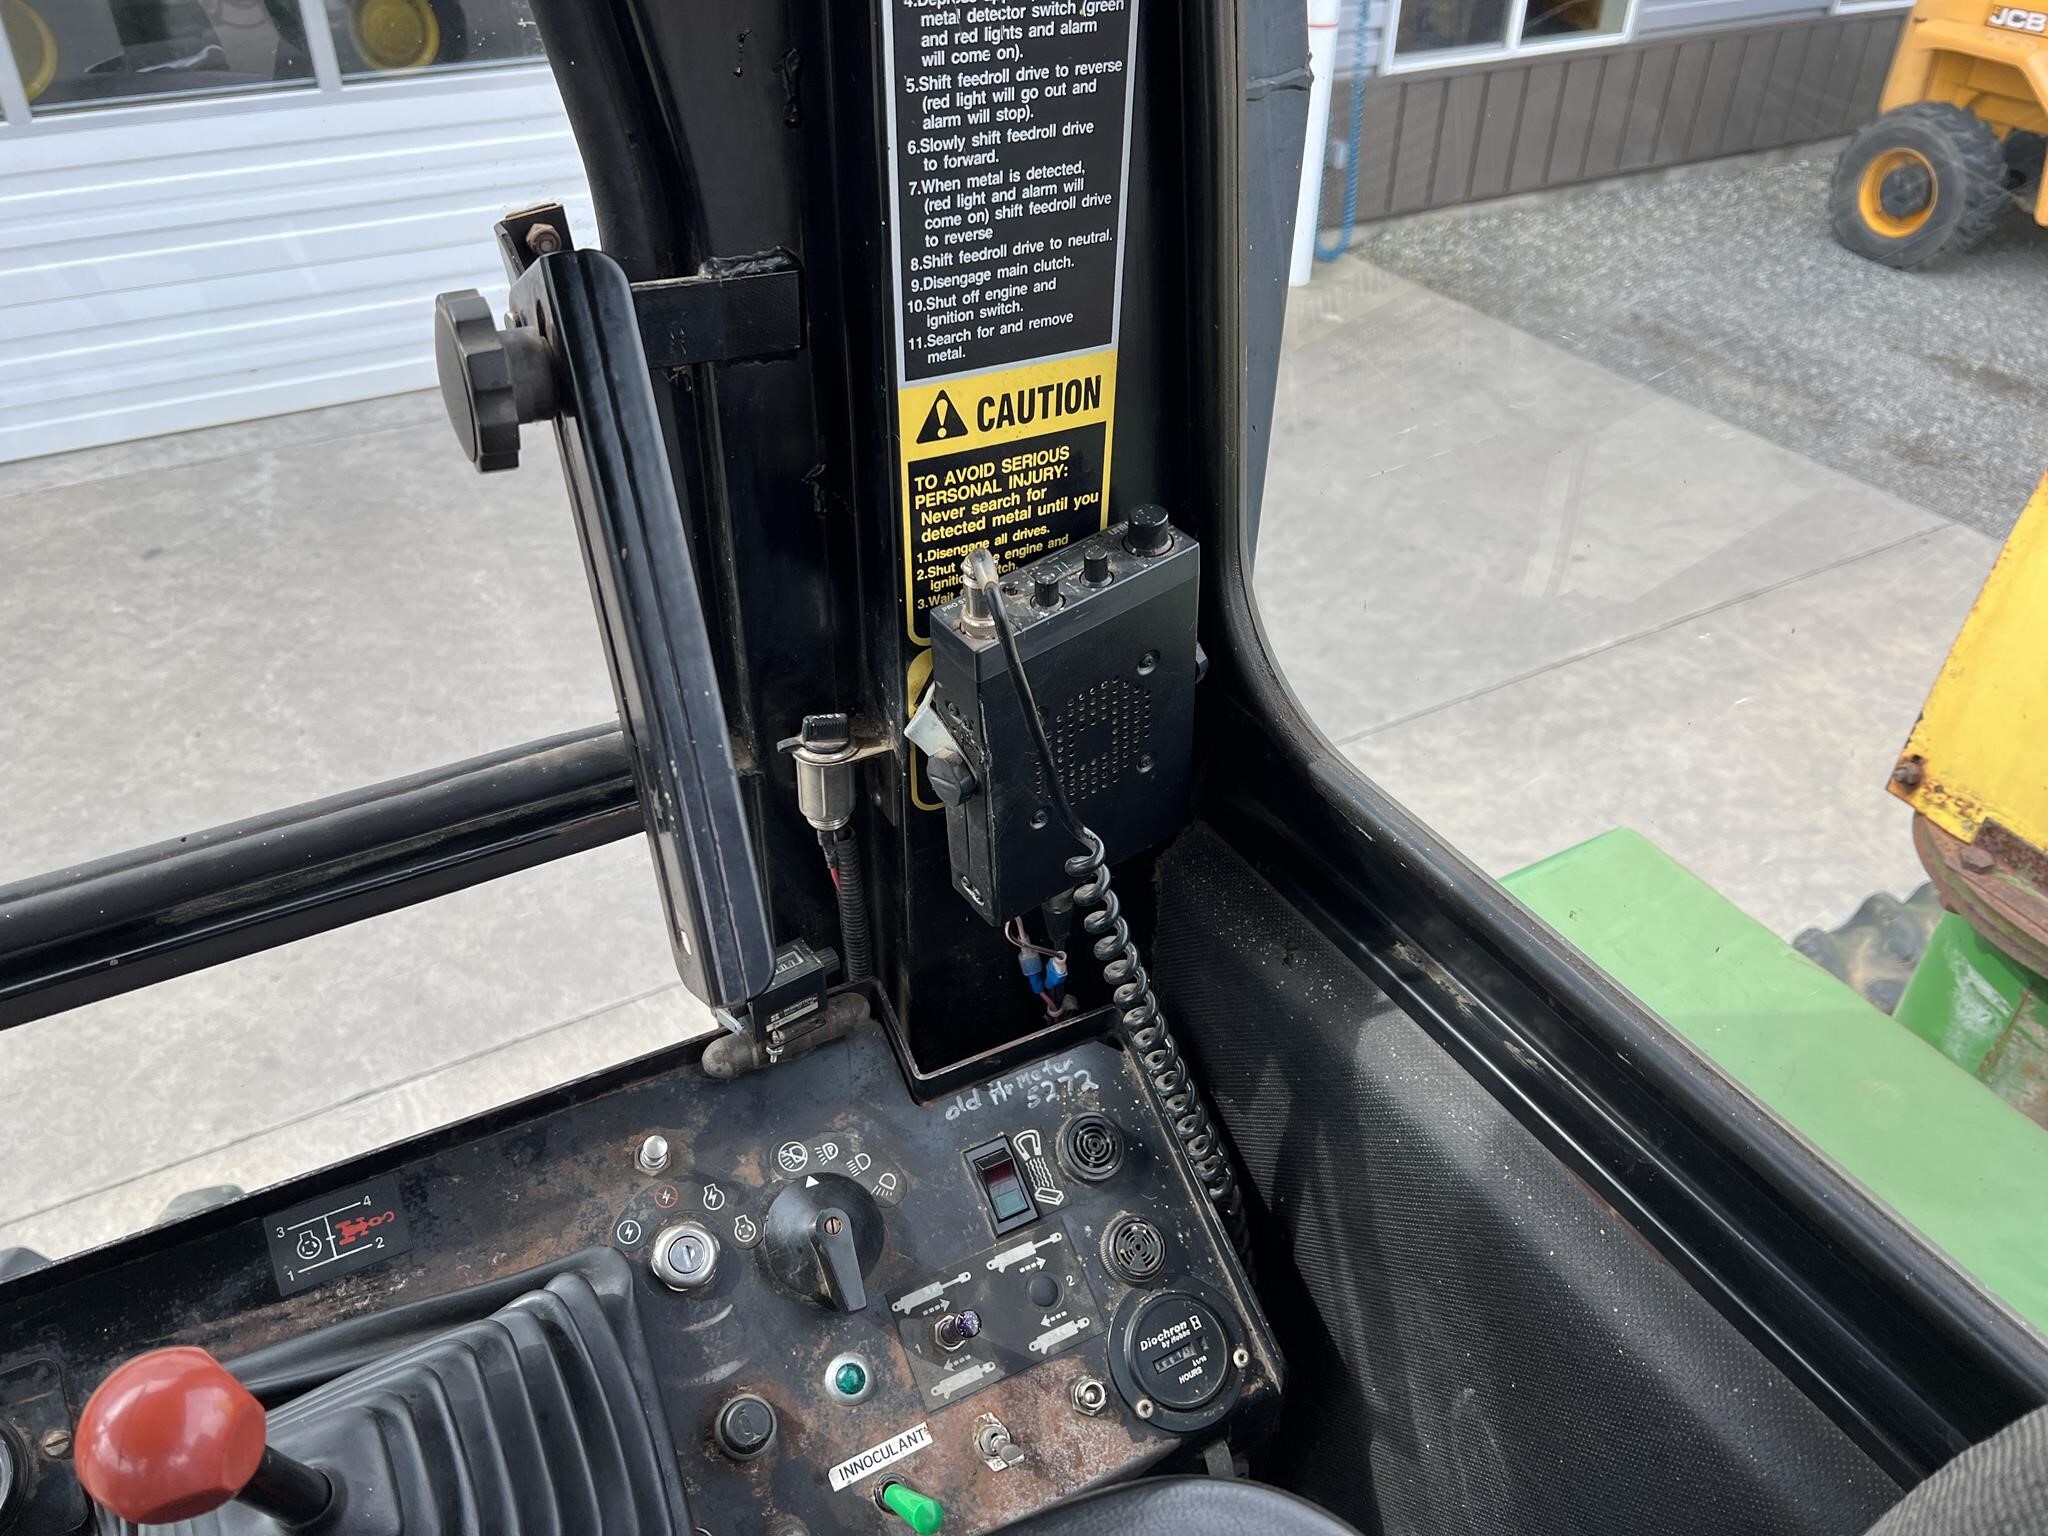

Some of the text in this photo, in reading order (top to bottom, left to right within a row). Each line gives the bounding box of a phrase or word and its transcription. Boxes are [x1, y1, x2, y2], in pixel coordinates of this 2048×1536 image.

[921, 8, 960, 27] metal
[967, 6, 1026, 23] detector
[1032, 0, 1076, 17] switch
[1989, 8, 2046, 32] JCB
[921, 20, 1097, 47] and red lights and alarm
[922, 44, 1023, 66] will come on).
[905, 61, 1122, 93] 5.Shift feedroll drive to reverse
[923, 78, 1096, 114] (red light will go out and
[923, 104, 1033, 130] alarm will stop).
[908, 121, 1094, 154] 6.Slowly shift feedroll drive
[924, 149, 999, 171] to forward.
[909, 160, 1085, 195] 7.When metal is detected,
[925, 178, 1084, 215] (red light and alarm will
[925, 193, 1111, 230] come on) shift feedroll drive
[911, 229, 1112, 271] 8.Shift feedroll drive to neutral.
[925, 228, 993, 247] to reverse
[911, 256, 1074, 292] 9.Disengage main clutch.
[908, 277, 1056, 313] 10.Shut off engine and
[927, 300, 1023, 329] ignition switch.
[909, 313, 1073, 350] 11.Search for and remove
[928, 346, 965, 364] metal.
[977, 375, 1101, 432] CAUTION
[914, 446, 1069, 491] TO AVOID SERIOUS
[915, 464, 1068, 510] PERSONAL INJURY:
[922, 488, 1047, 526] Never search for
[922, 492, 1098, 542] detected metal until you
[917, 539, 990, 564] 1.Disengage
[994, 532, 1007, 546] all
[1012, 526, 1050, 541] drives.
[917, 563, 955, 580] 2.Shut
[1005, 543, 1043, 559] engine
[1048, 534, 1068, 548] and
[918, 592, 955, 609] 3.Wait
[945, 1088, 982, 1120] old
[1027, 1069, 1099, 1110] 5272
[363, 1195, 371, 1206] 4
[276, 1226, 285, 1238] 3
[375, 1238, 385, 1249] 2
[286, 1270, 294, 1281] 1
[1066, 1276, 1075, 1287] 2
[915, 1344, 923, 1354] 1
[1140, 1321, 1188, 1352] Diochron
[1161, 1329, 1192, 1349] by Hobbs
[1178, 1367, 1203, 1384] HOURS
[838, 1428, 924, 1480] INNOCULANT
